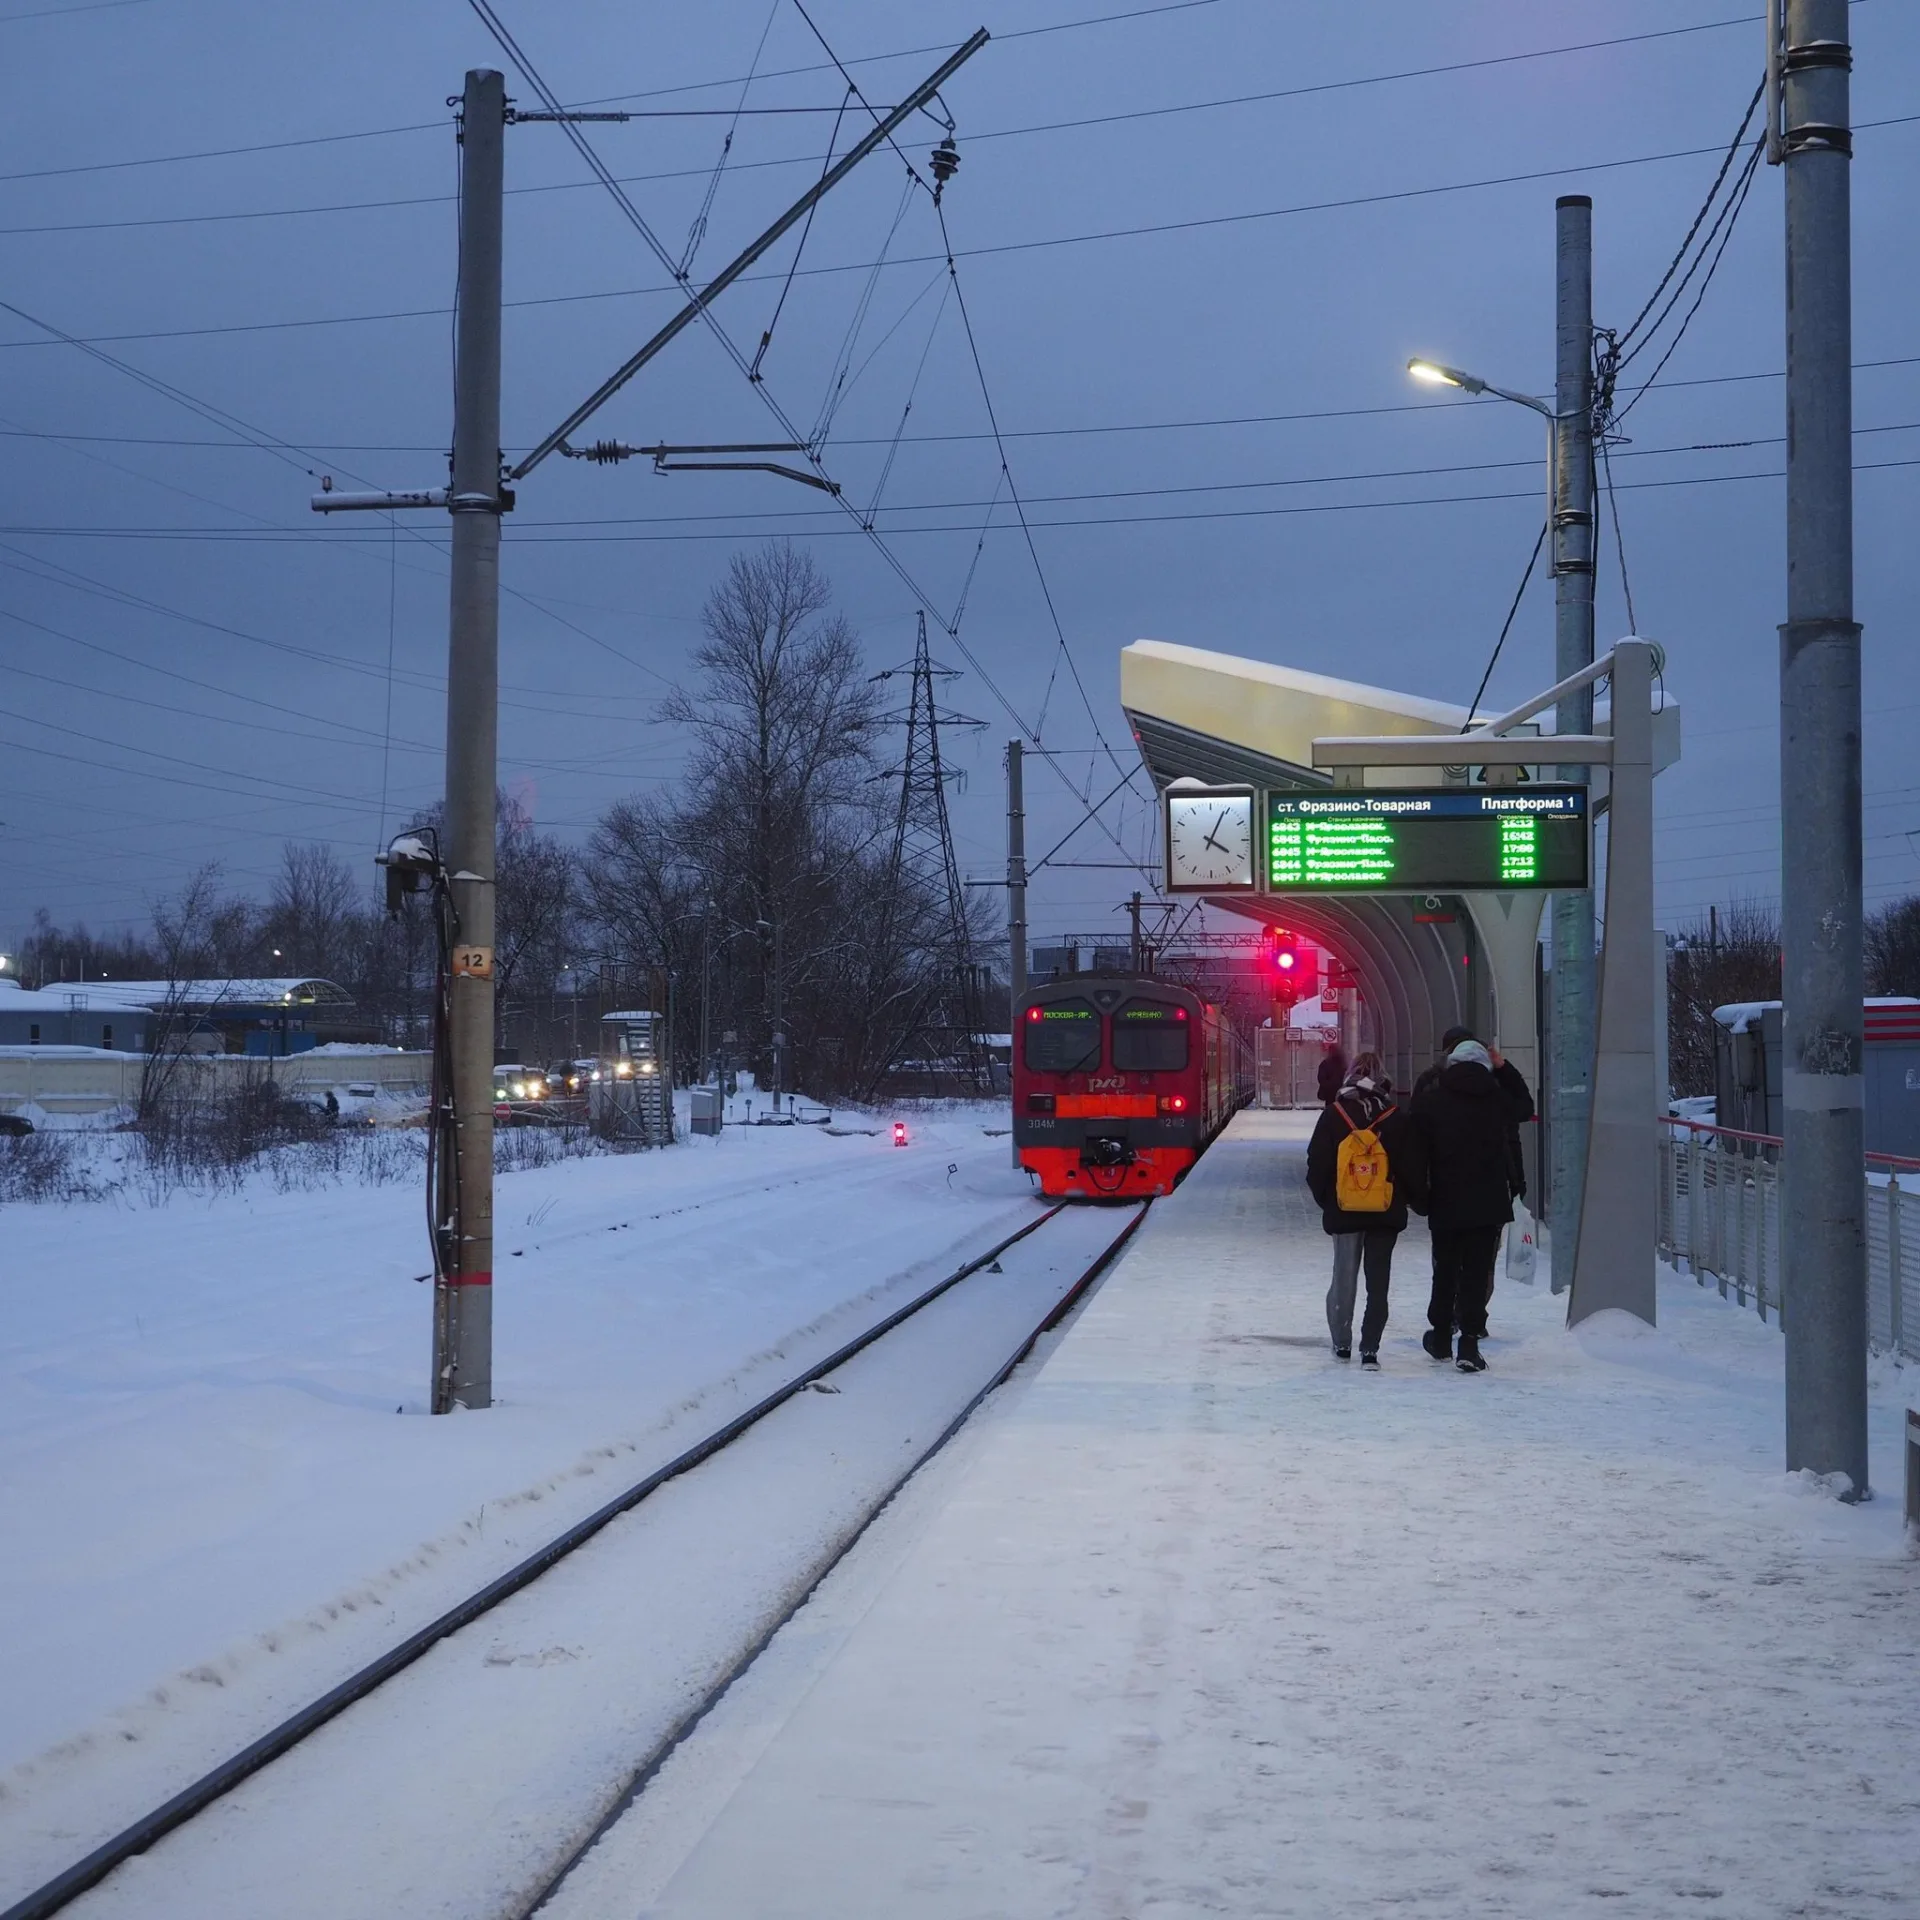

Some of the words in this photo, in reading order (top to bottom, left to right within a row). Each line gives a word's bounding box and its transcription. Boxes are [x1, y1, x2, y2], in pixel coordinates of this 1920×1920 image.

[1277, 802, 1295, 813] ст.
[1299, 799, 1432, 815] Фрязино-Товарная
[1481, 797, 1564, 812] Платформа
[1567, 796, 1575, 809] 1
[1327, 816, 1351, 824] Станция
[461, 952, 484, 968] 12
[1043, 1010, 1093, 1020] МОСКВА-ЯР.
[1127, 1010, 1162, 1019] ФРЯЗИНО
